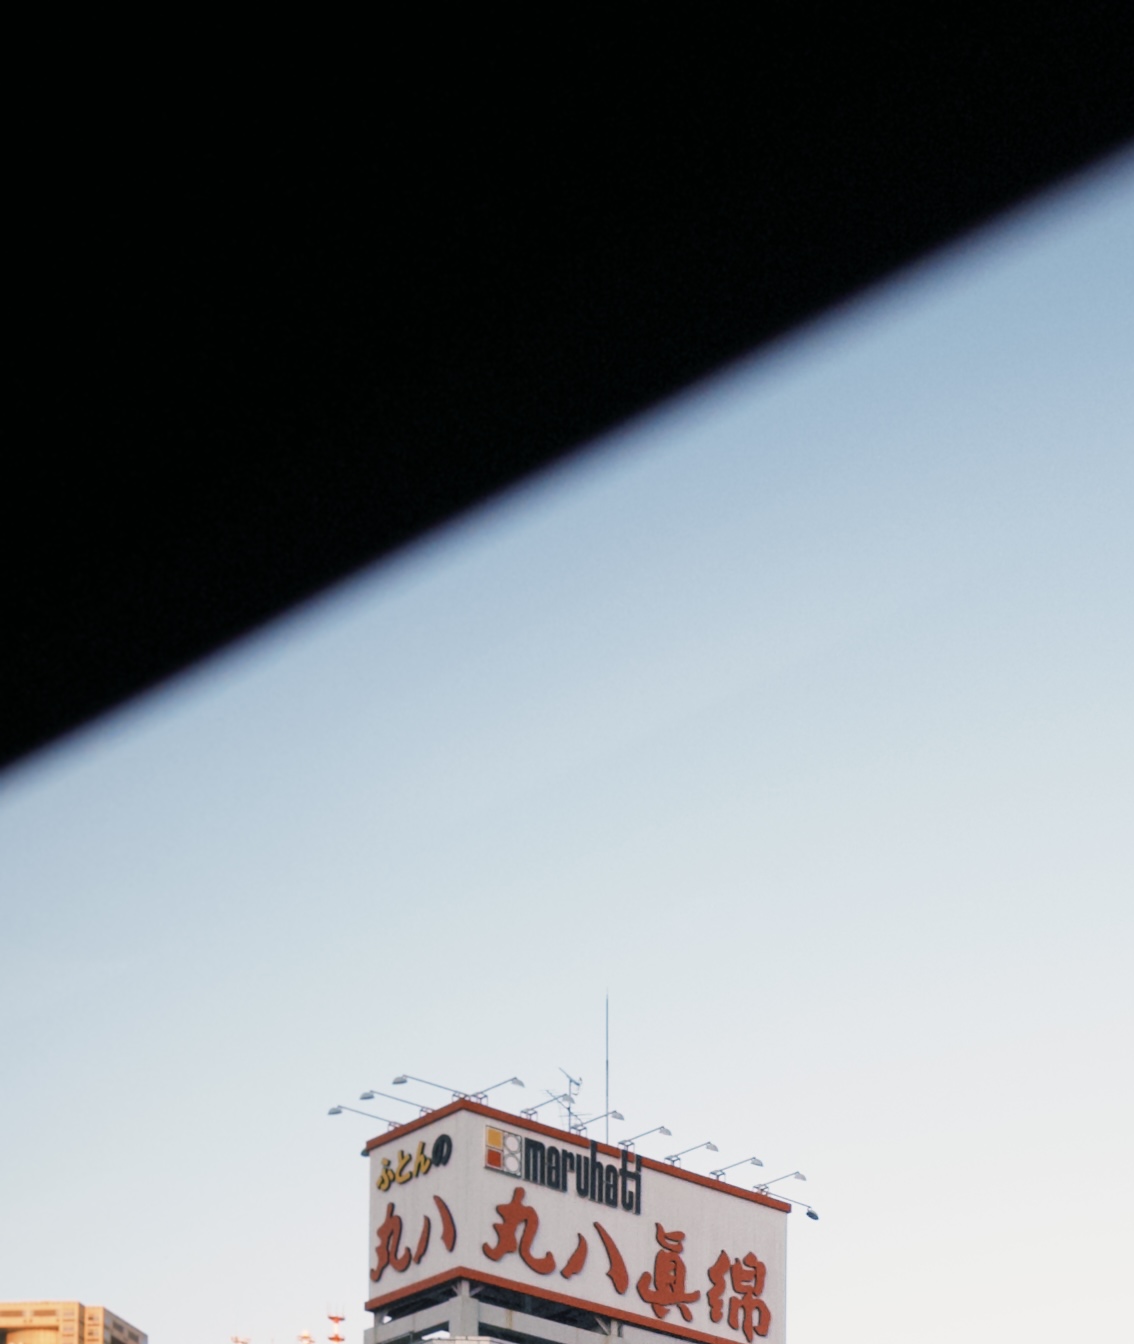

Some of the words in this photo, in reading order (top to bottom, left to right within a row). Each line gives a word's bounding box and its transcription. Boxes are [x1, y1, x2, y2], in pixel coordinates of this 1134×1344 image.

[376, 1133, 453, 1191] ふとんの
[523, 1137, 643, 1215] maruhati
[370, 1195, 456, 1282] 丸八
